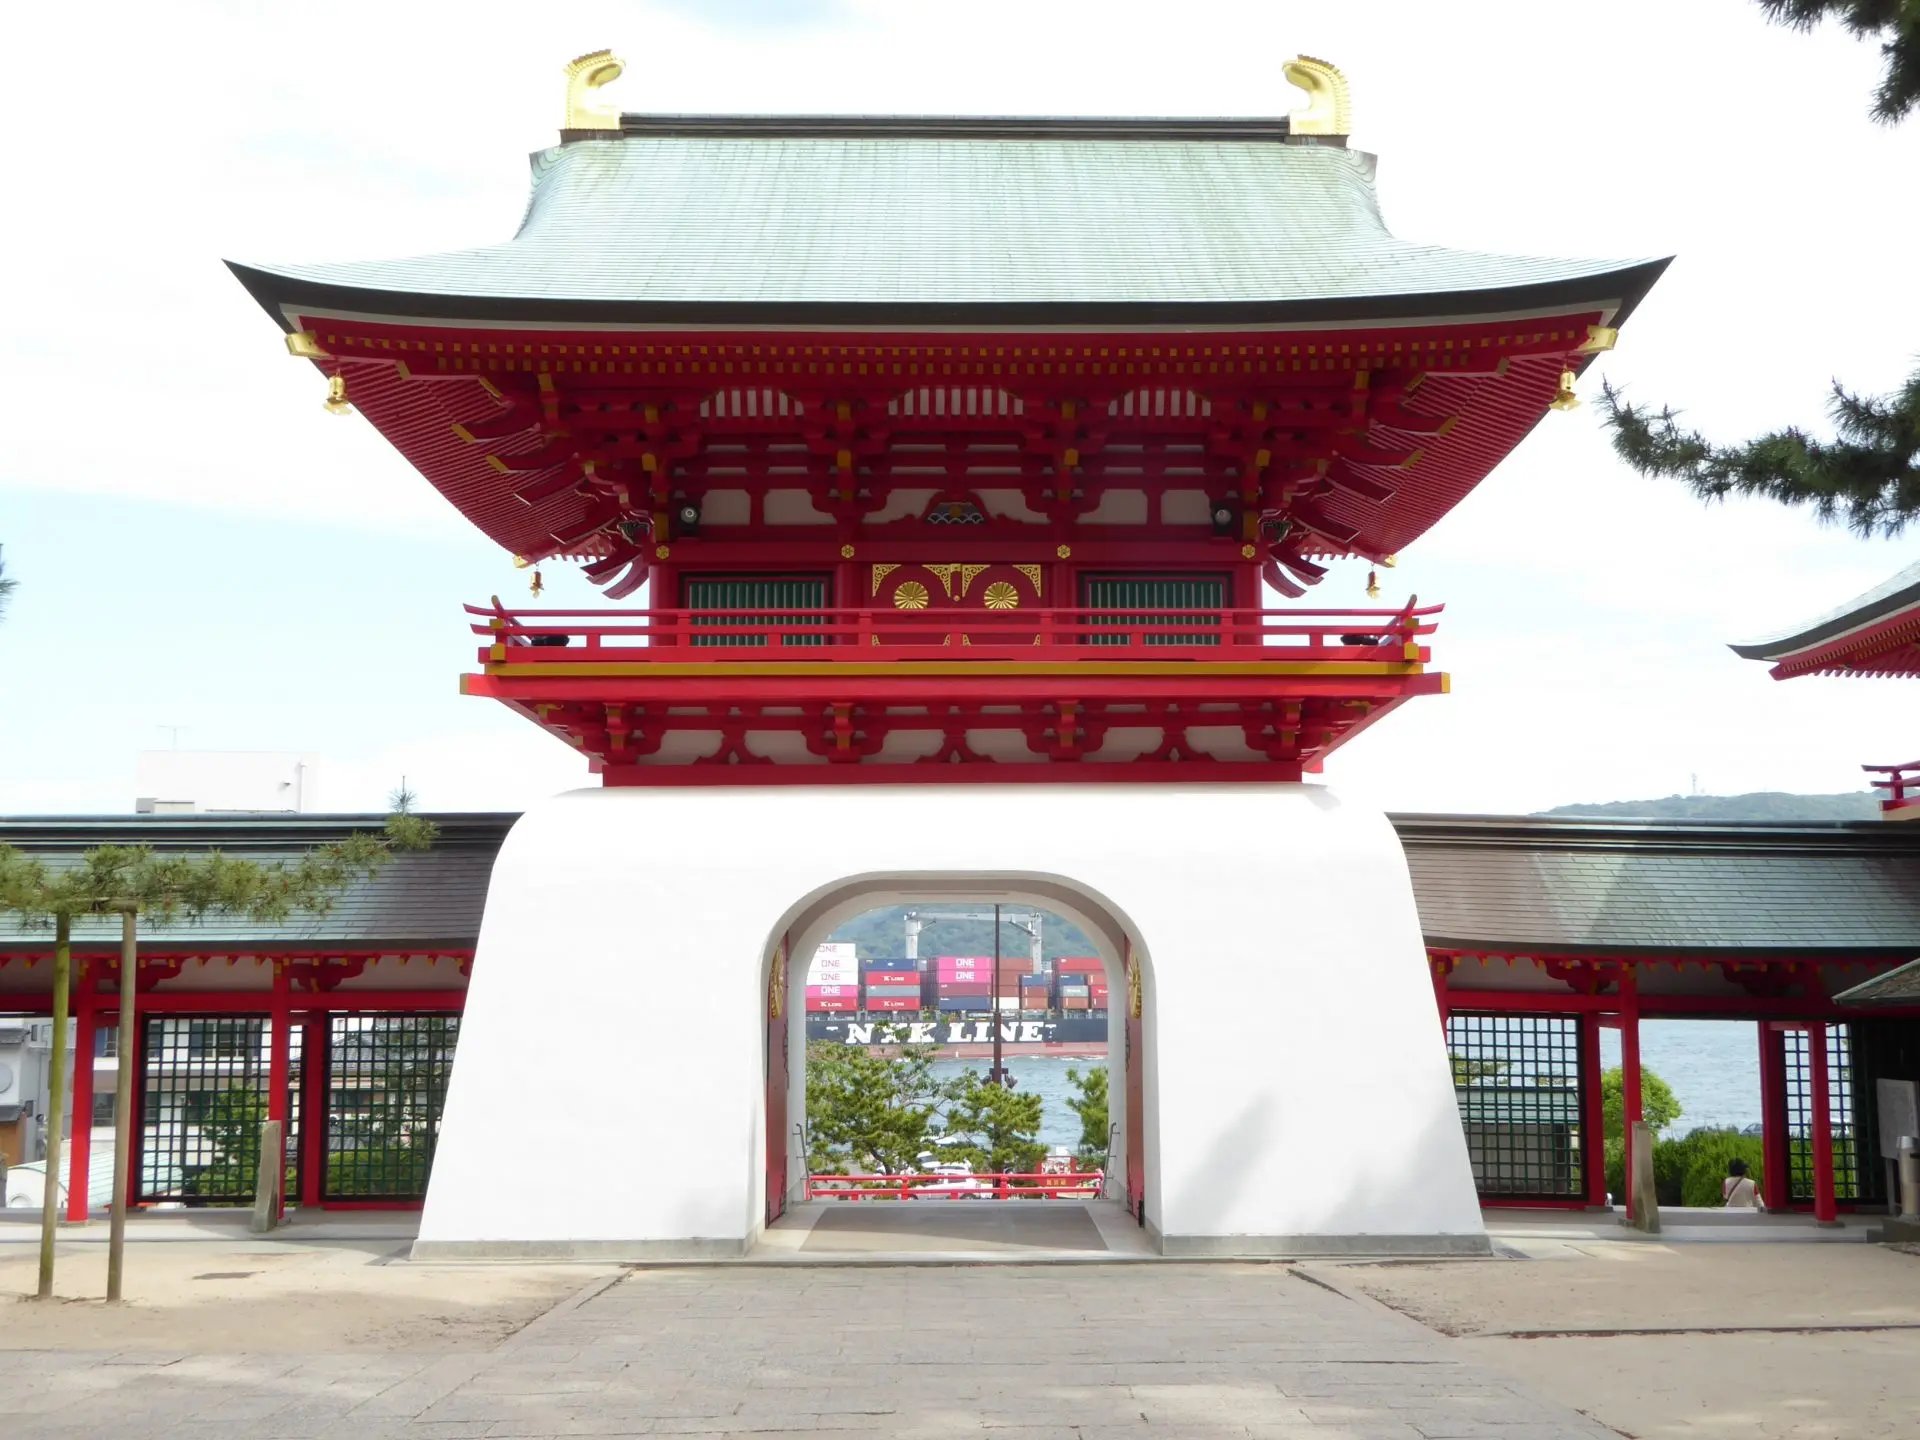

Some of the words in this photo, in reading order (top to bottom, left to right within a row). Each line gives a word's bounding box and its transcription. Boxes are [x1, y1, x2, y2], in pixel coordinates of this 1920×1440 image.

[818, 944, 838, 953] ONE
[821, 959, 840, 968] ONE
[956, 958, 975, 967] ONE
[821, 973, 840, 981] ONE
[956, 971, 975, 980] ONE
[821, 985, 840, 995] ONE
[947, 1021, 1044, 1042] LINE
